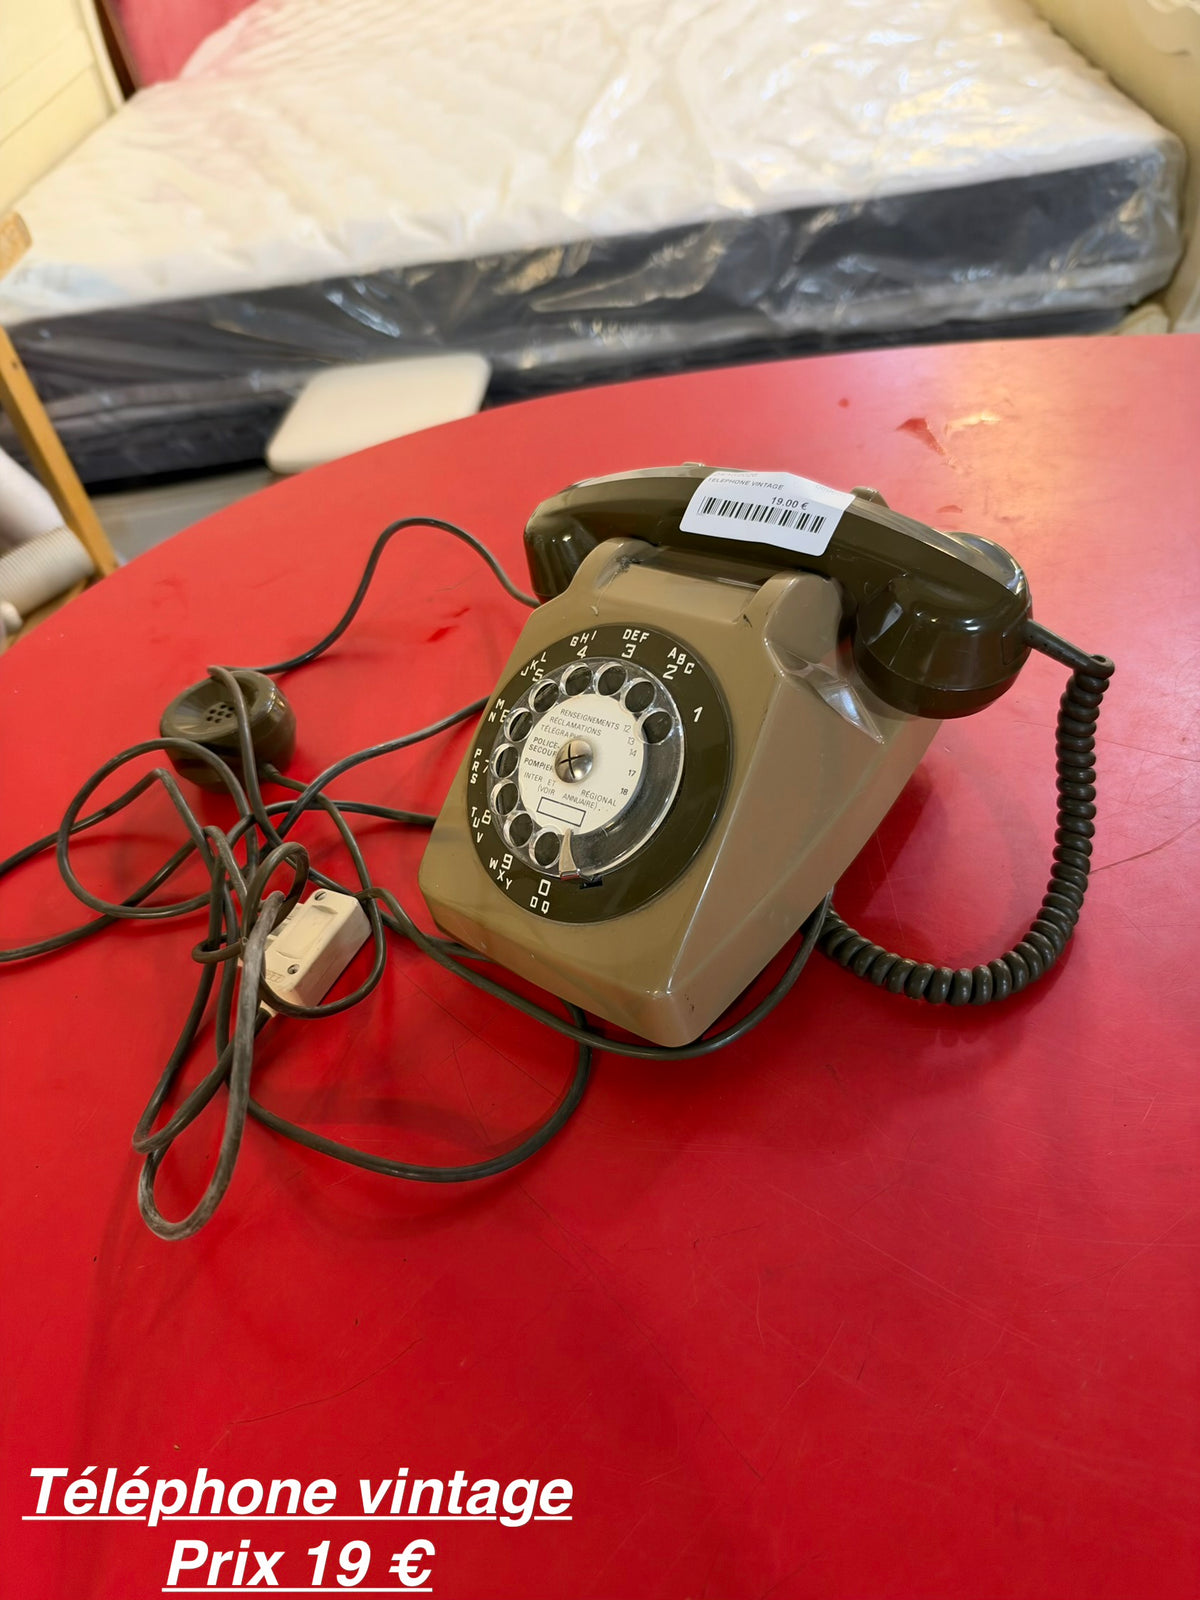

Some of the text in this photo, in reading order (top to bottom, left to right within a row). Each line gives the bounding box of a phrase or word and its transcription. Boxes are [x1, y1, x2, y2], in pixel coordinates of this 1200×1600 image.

[752, 480, 784, 490] VINTAGE
[771, 496, 809, 511] 19.00 €
[570, 630, 597, 646] GHI
[622, 629, 650, 643] DEF
[577, 645, 588, 659] 4
[621, 643, 637, 659] 3
[520, 652, 547, 676] JKL
[667, 646, 695, 675] ABC
[532, 669, 544, 684] 5
[662, 664, 679, 680] 2
[560, 708, 632, 733] RENSEIGNEMENTS 12
[693, 706, 704, 723] 1
[549, 716, 602, 737] RÉCLAMATIONS
[533, 736, 560, 749] POLICE-
[627, 736, 635, 745] 13
[629, 748, 637, 757] 14
[482, 759, 492, 774] 7
[628, 769, 637, 777] 17
[523, 772, 617, 807] INTER ET RÉGIONAL
[537, 784, 556, 796] (VOIR
[620, 788, 629, 796] 18
[471, 806, 484, 844] TUV
[501, 853, 514, 870] 9
[489, 857, 513, 890] WXY
[538, 878, 552, 897] 0
